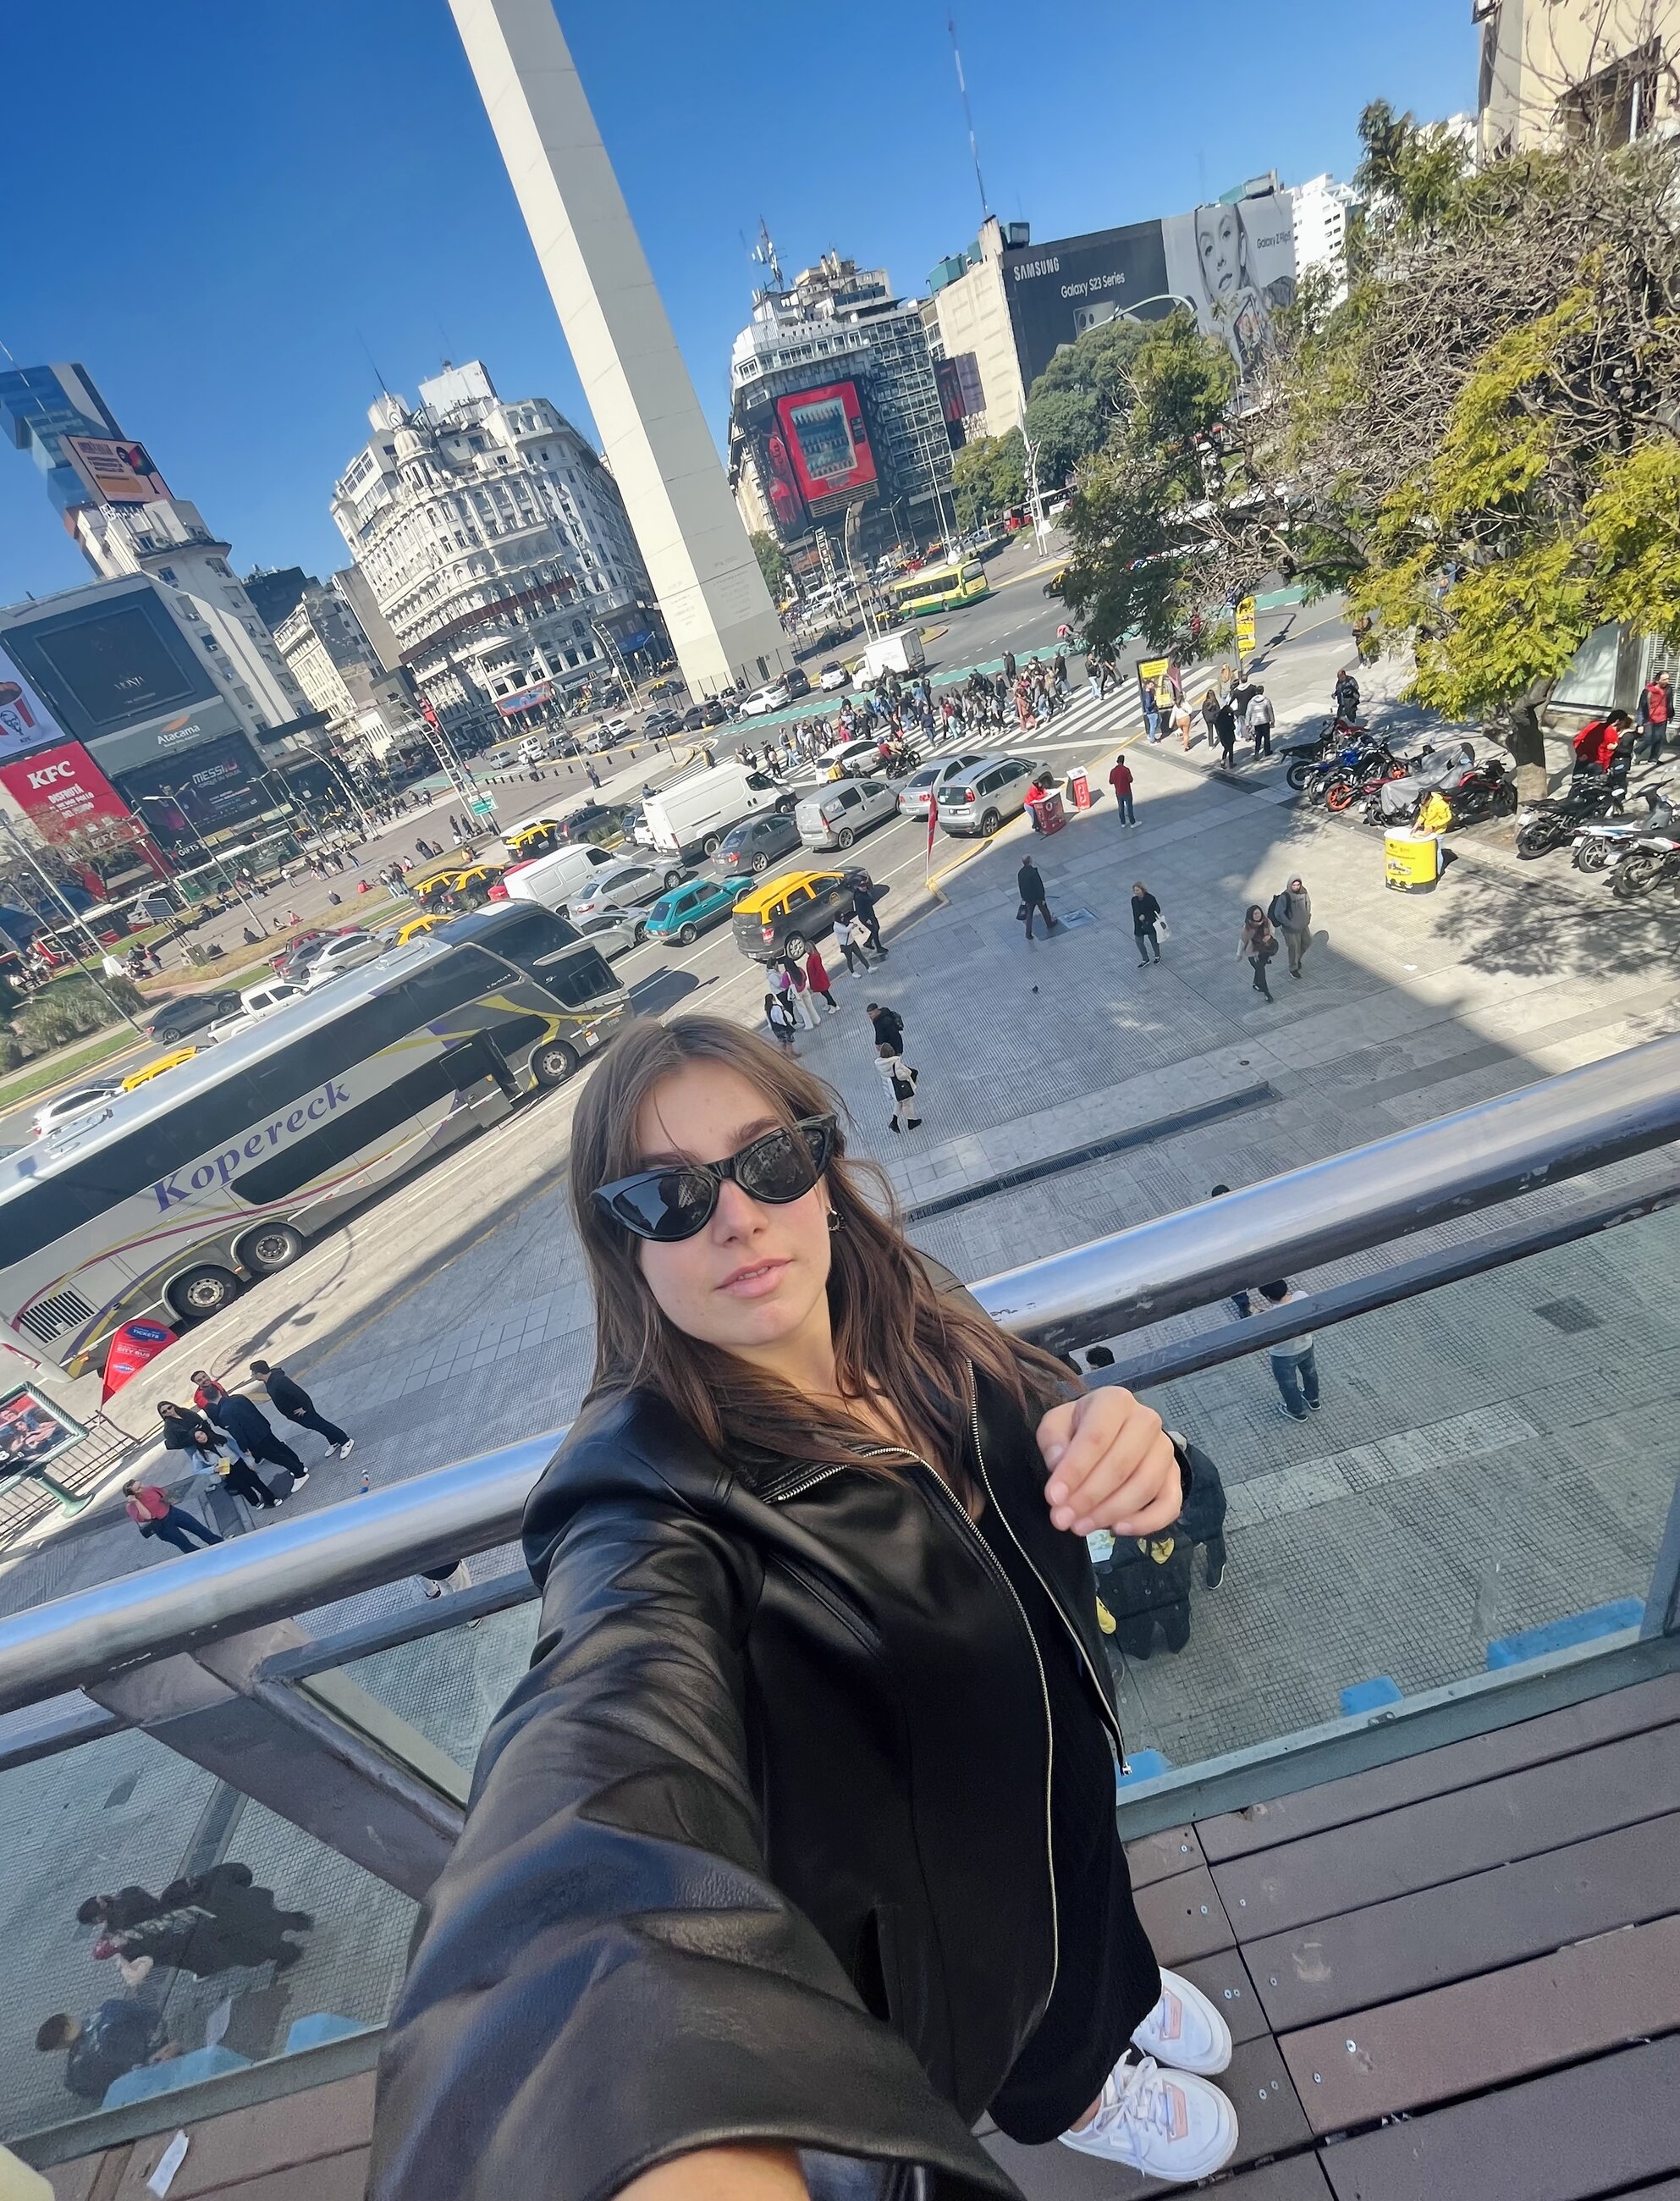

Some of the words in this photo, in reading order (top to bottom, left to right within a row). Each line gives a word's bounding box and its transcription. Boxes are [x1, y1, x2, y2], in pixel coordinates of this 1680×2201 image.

[1257, 237, 1275, 249] Galaxy
[1275, 233, 1280, 245] Z
[1013, 257, 1060, 282] SAMSUNG
[1060, 281, 1088, 298] Galaxy
[1088, 276, 1102, 291] S23
[1102, 271, 1126, 288] Series
[157, 725, 201, 745] Atacama
[26, 760, 76, 790] KFC
[47, 783, 85, 804] DISFRUTÁ
[153, 1081, 350, 1214] Kopereck
[133, 1328, 160, 1339] TICKETS
